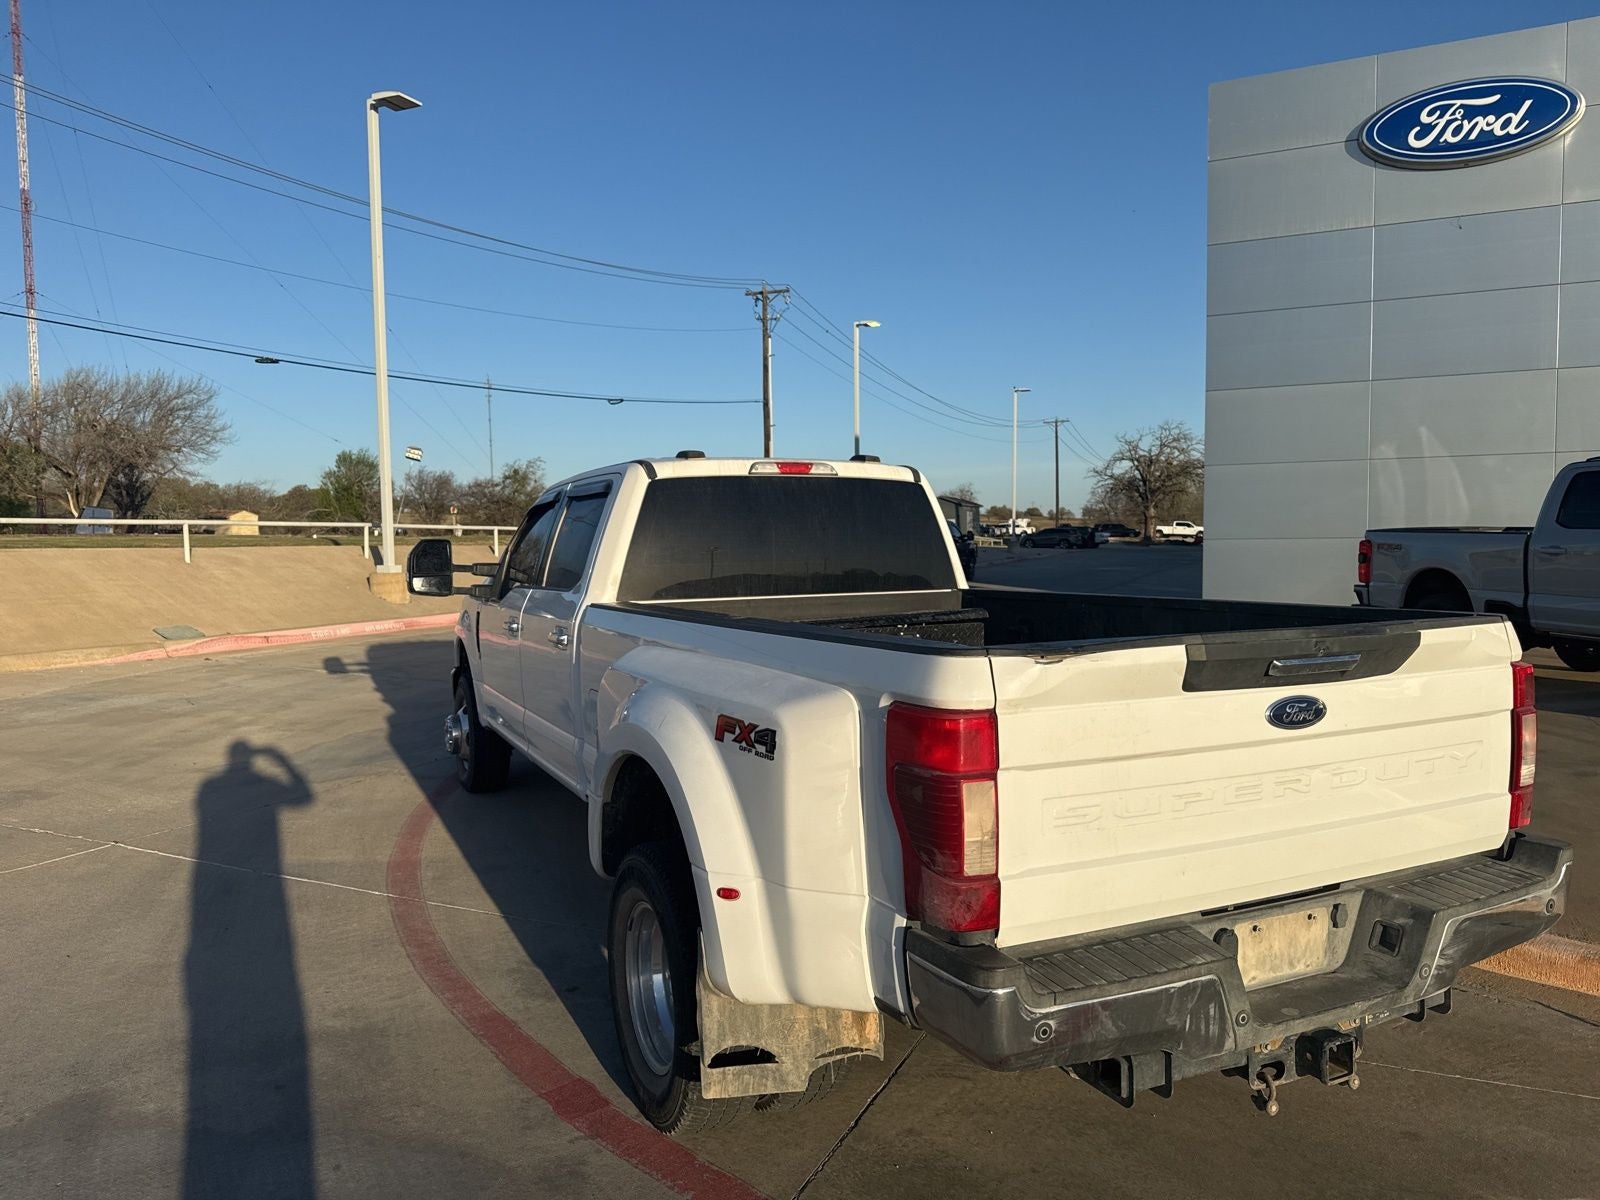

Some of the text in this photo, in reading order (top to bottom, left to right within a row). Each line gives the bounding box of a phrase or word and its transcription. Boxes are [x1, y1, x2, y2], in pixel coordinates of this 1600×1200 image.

[1407, 94, 1534, 149] Ford
[1283, 703, 1315, 722] Ford
[714, 714, 776, 755] FX4
[738, 745, 774, 761] OFF ROAD
[1051, 750, 1479, 829] SUPER DUTY
